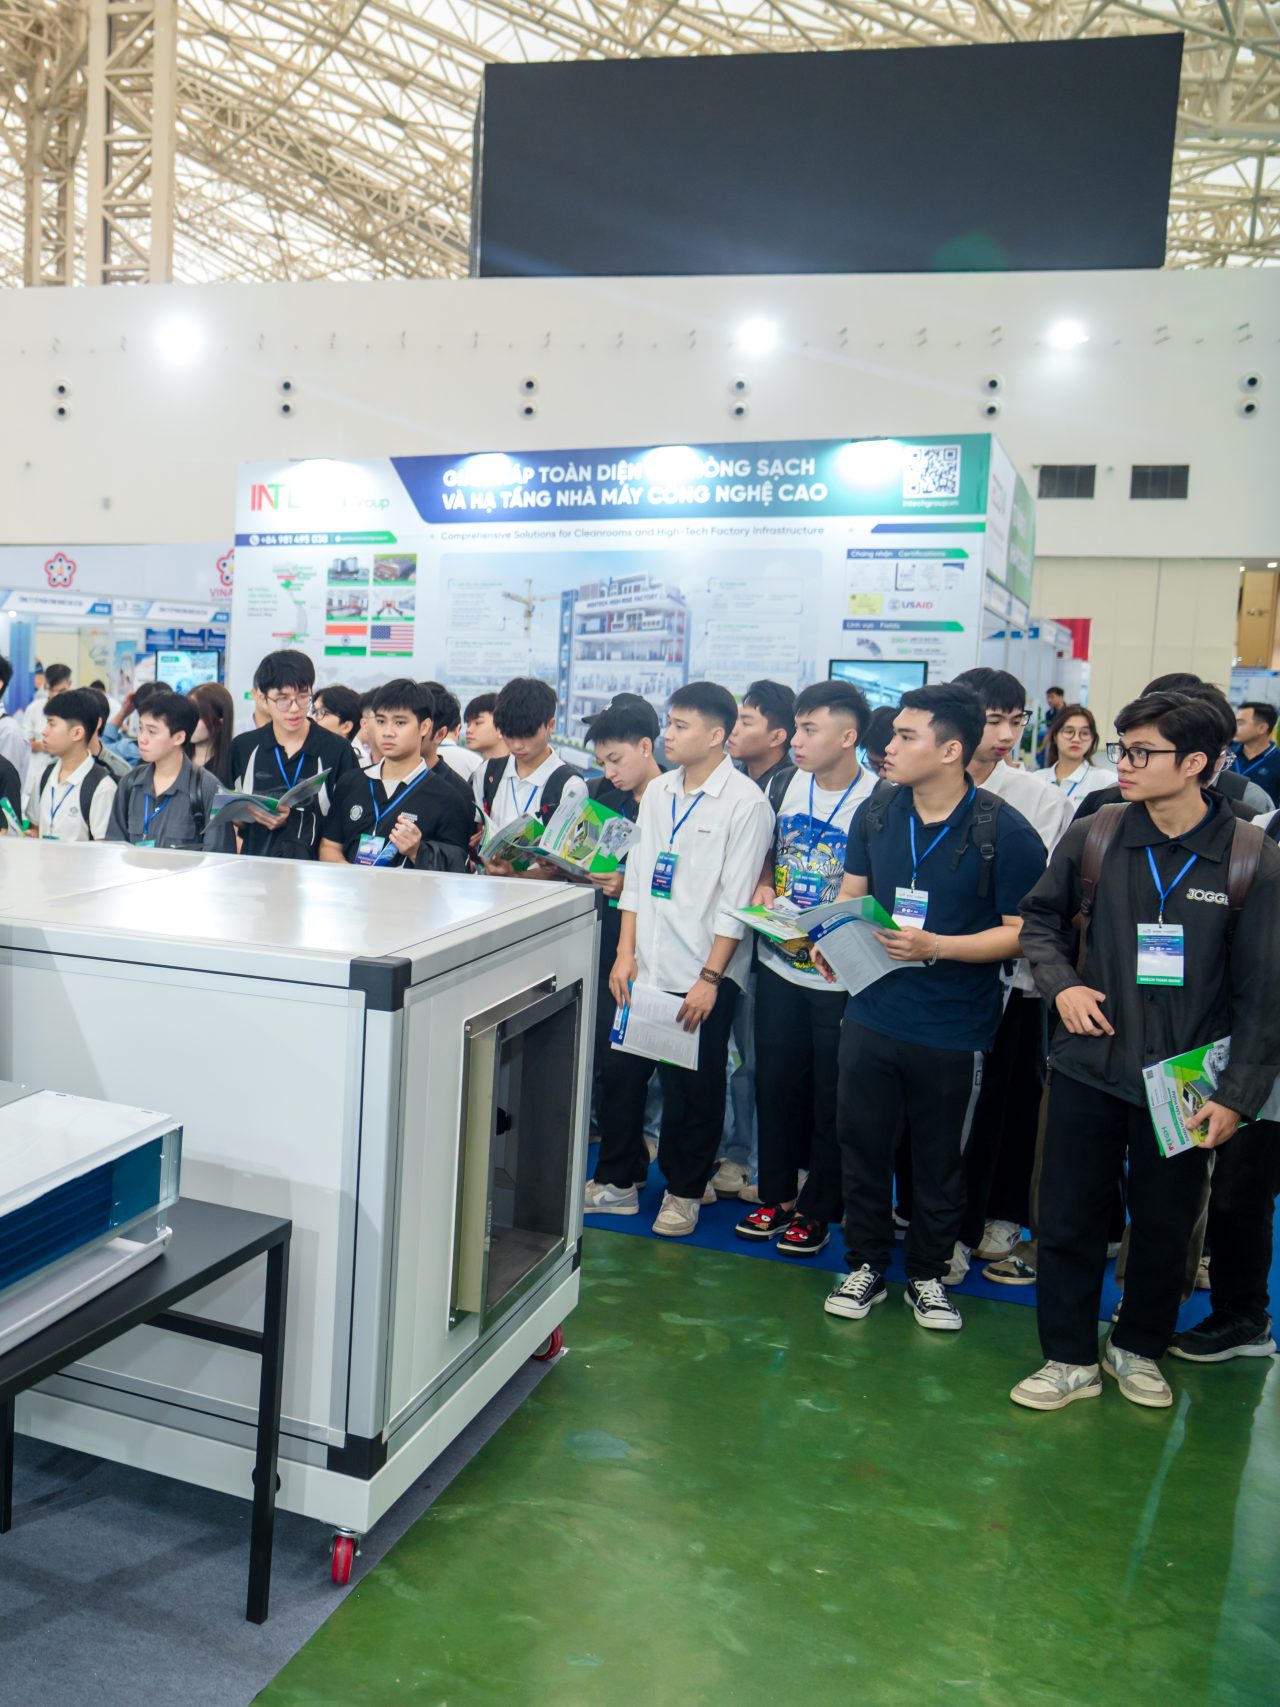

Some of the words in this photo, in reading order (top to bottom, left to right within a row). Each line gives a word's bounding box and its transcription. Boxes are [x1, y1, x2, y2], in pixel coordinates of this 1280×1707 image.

[539, 461, 592, 484] TOÀN
[596, 458, 642, 486] DIỆN
[756, 458, 816, 481] SẠCH
[442, 488, 467, 510] VÀ
[469, 490, 497, 514] HẠ
[556, 485, 597, 507] NHÀ
[601, 483, 644, 506] MÁY
[715, 480, 774, 507] NGHỆ
[777, 482, 829, 502] CAO
[440, 530, 512, 542] Comprehensive
[514, 529, 556, 539] Solutions
[559, 529, 572, 538] for
[574, 527, 632, 538] Cleanrooms
[635, 527, 655, 537] and
[710, 525, 750, 537] Factory
[752, 524, 825, 536] Infrastructure
[901, 600, 934, 610] USAID
